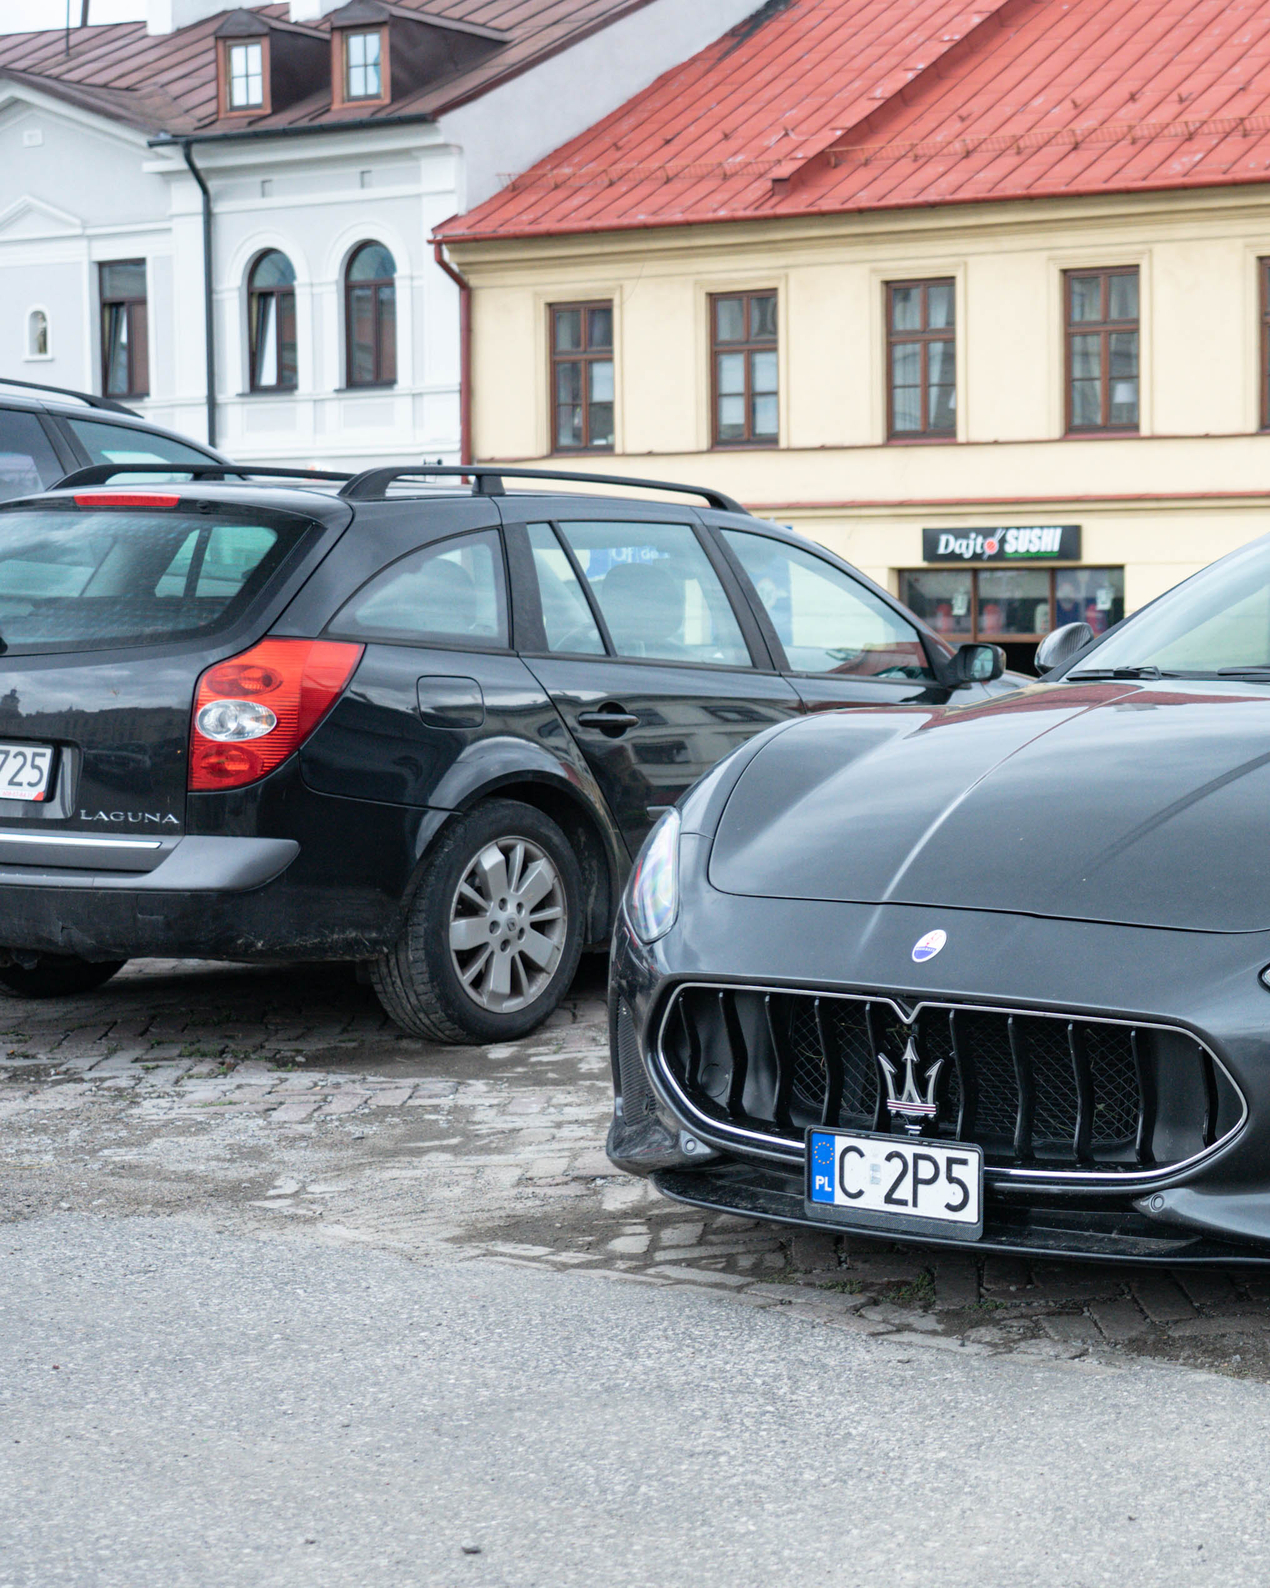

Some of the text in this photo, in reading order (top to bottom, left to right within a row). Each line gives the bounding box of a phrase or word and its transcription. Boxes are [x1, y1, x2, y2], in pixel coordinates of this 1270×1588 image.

[1003, 527, 1063, 553] SUSHI
[79, 809, 181, 825] LAGUNA
[815, 1175, 832, 1192] PL
[838, 1145, 970, 1213] C 2P5
